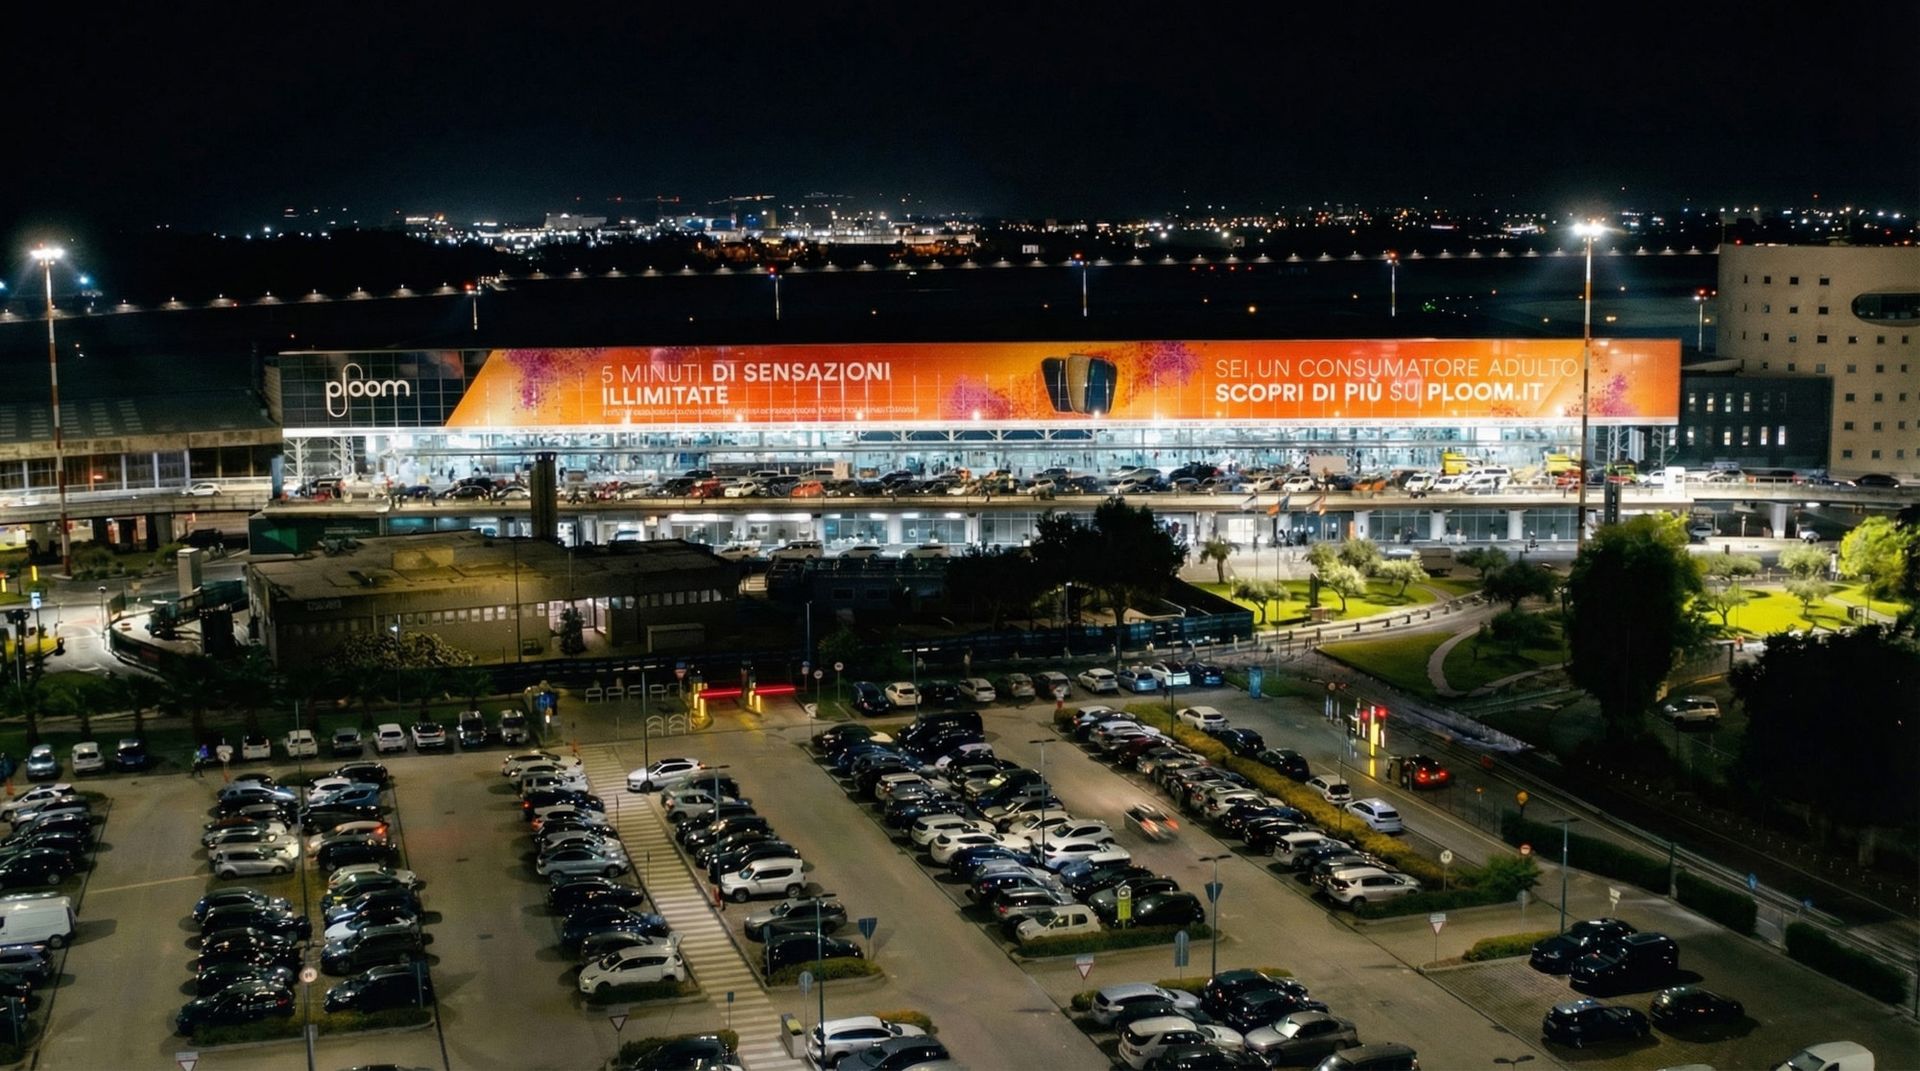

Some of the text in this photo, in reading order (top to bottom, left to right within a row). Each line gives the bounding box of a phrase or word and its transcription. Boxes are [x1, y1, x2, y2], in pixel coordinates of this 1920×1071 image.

[601, 362, 891, 383] 5 MINUTI DI SENSAZIONI
[1215, 358, 1578, 378] SEI UN CONSUMATORE ADULTO
[325, 362, 411, 418] ploom
[602, 386, 729, 406] ILLIMITATE
[1215, 378, 1544, 402] SCOPRI DI PIÙ SU PLOOM.IT
